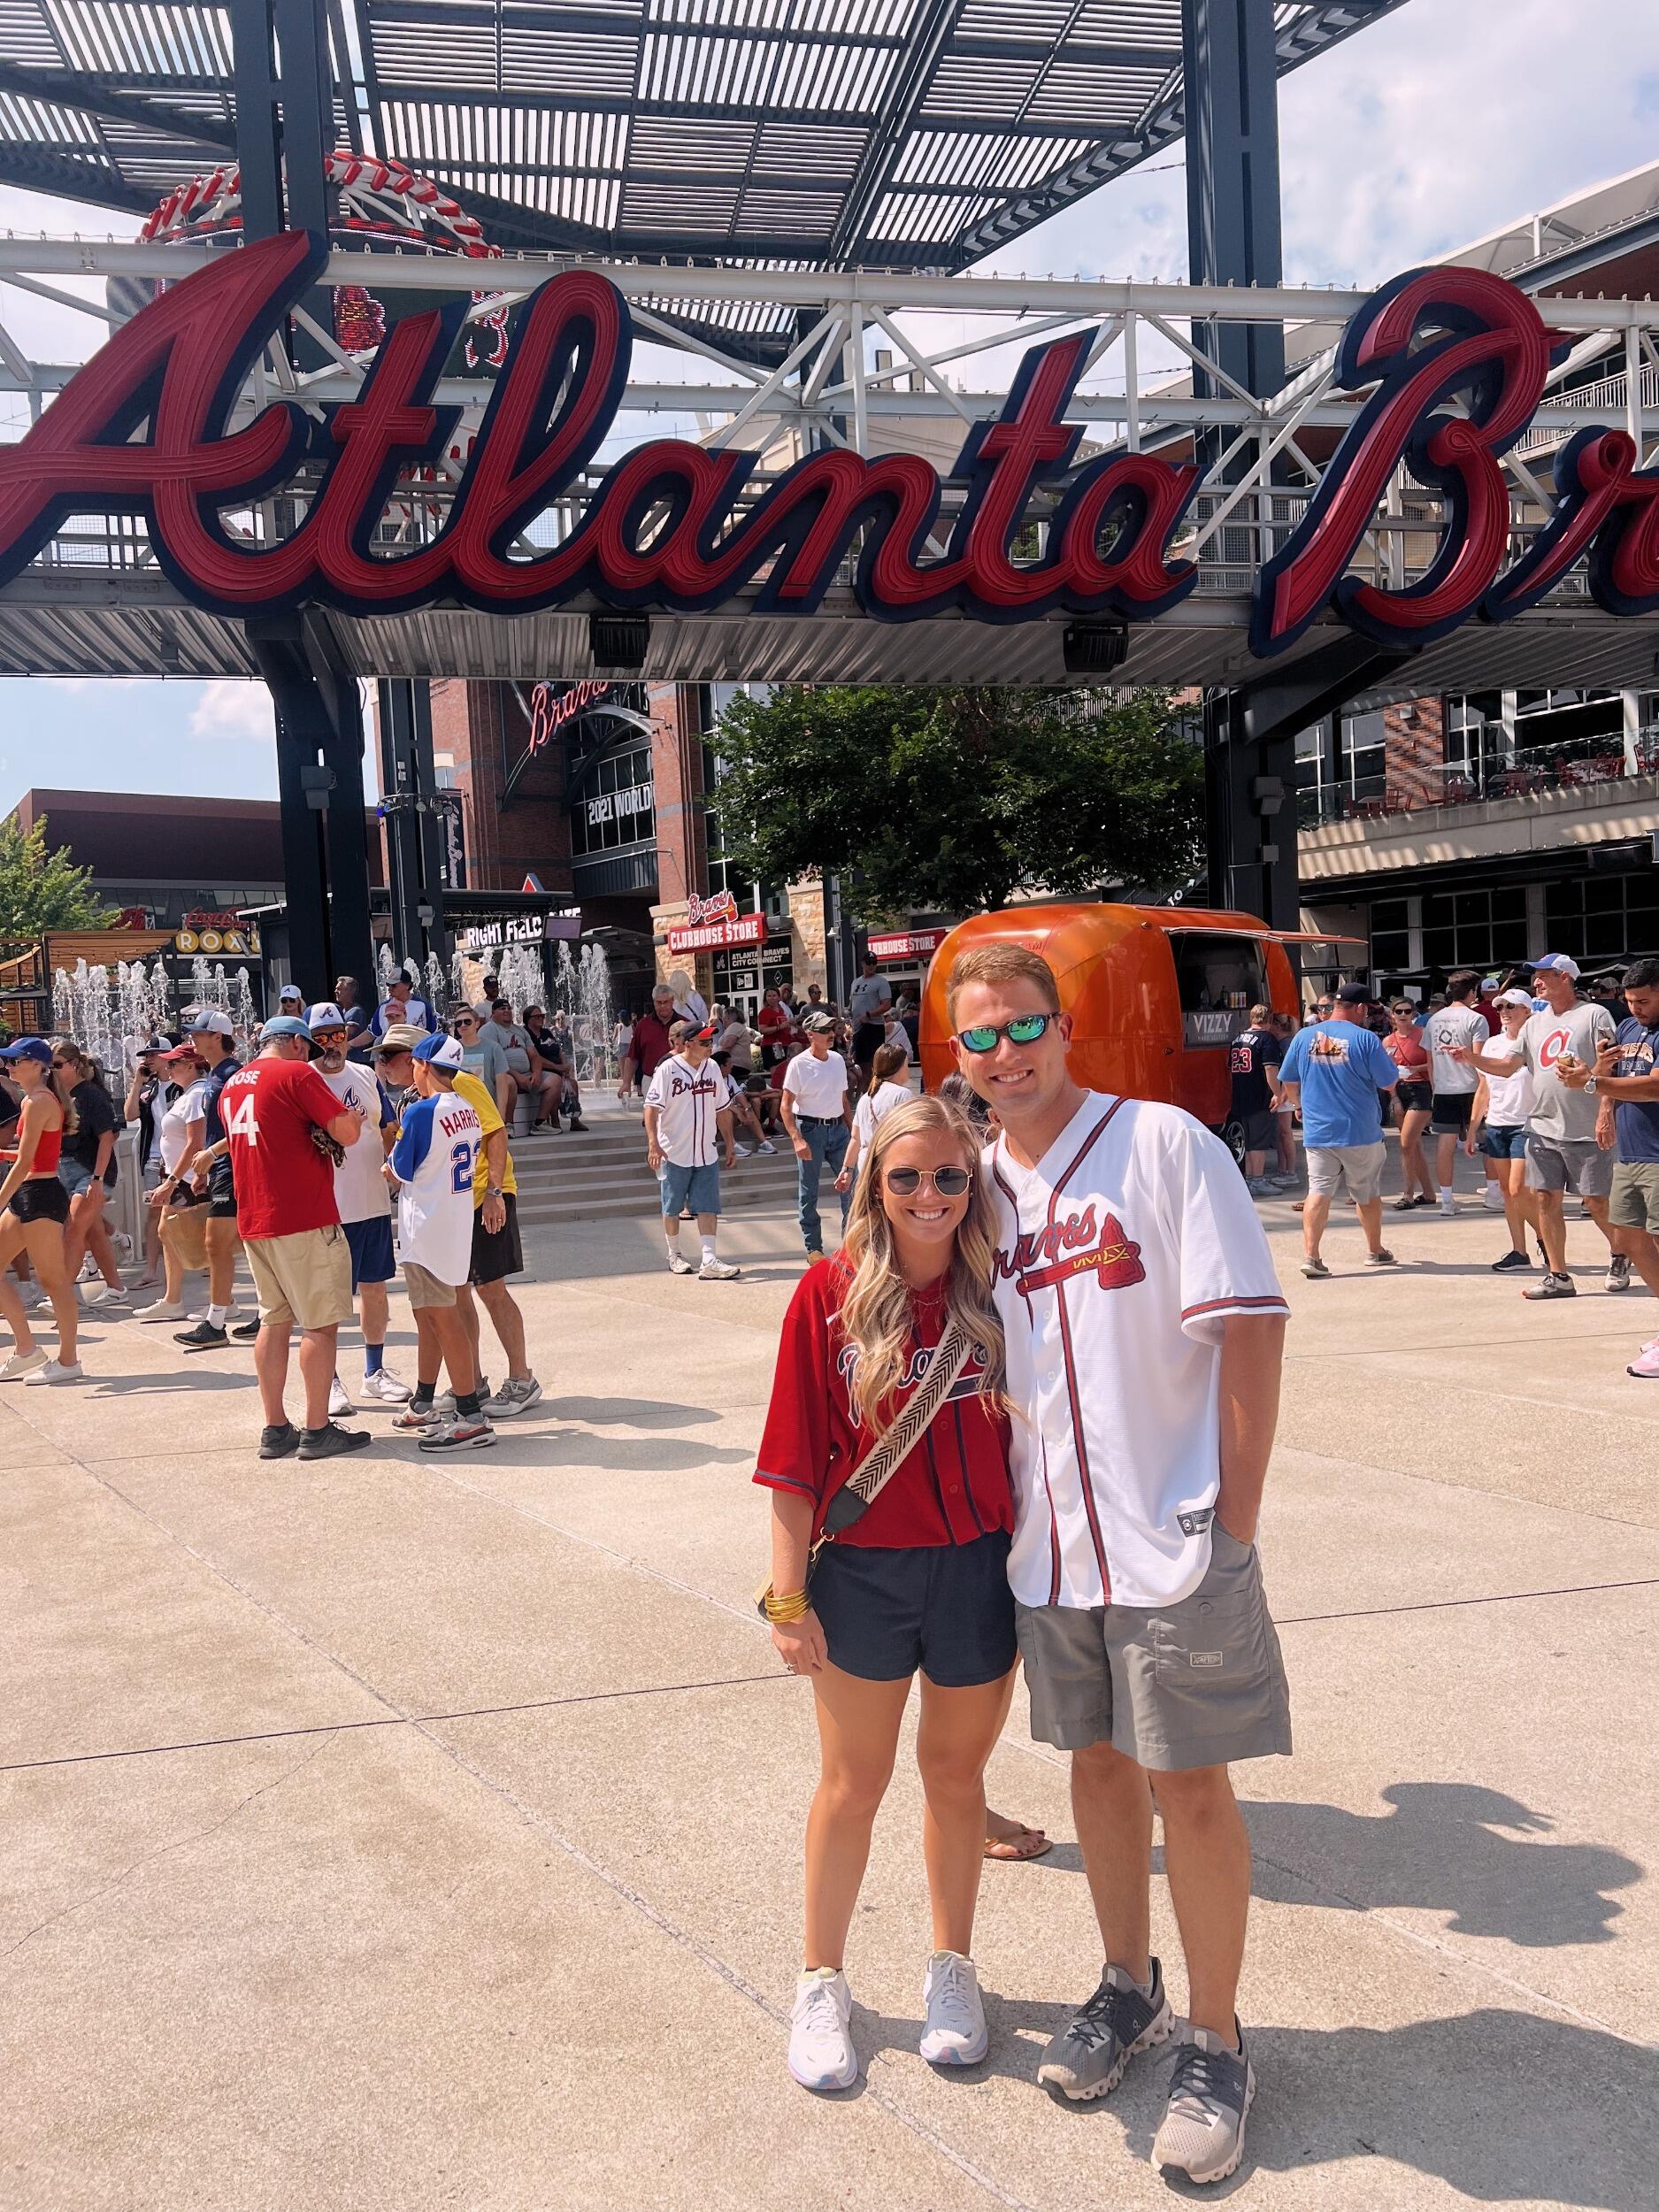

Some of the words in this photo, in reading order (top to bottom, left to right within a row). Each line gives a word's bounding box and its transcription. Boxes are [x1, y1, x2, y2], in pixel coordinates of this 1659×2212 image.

[0, 230, 1205, 621] Atlanta
[588, 796, 613, 825] 2021
[614, 786, 652, 818] WORLD
[689, 888, 729, 926] Braves
[466, 923, 502, 947] RIGHT
[506, 916, 542, 941] FIELD
[671, 926, 724, 950] CLUBHOUSE
[726, 920, 758, 941] STORE
[868, 939, 909, 956] LUBHOUSE
[909, 936, 935, 951] STORE
[732, 951, 759, 961] ATLANTA
[764, 948, 790, 956] BRAVES
[732, 958, 747, 967] CITY
[1194, 1014, 1233, 1033] VIZZY
[1231, 1048, 1252, 1073] 23
[228, 1070, 261, 1090] ROSE
[672, 1078, 714, 1097] Braves
[223, 1093, 260, 1147] 14
[439, 1109, 480, 1138] HARRIS
[992, 1202, 1096, 1290] raves
